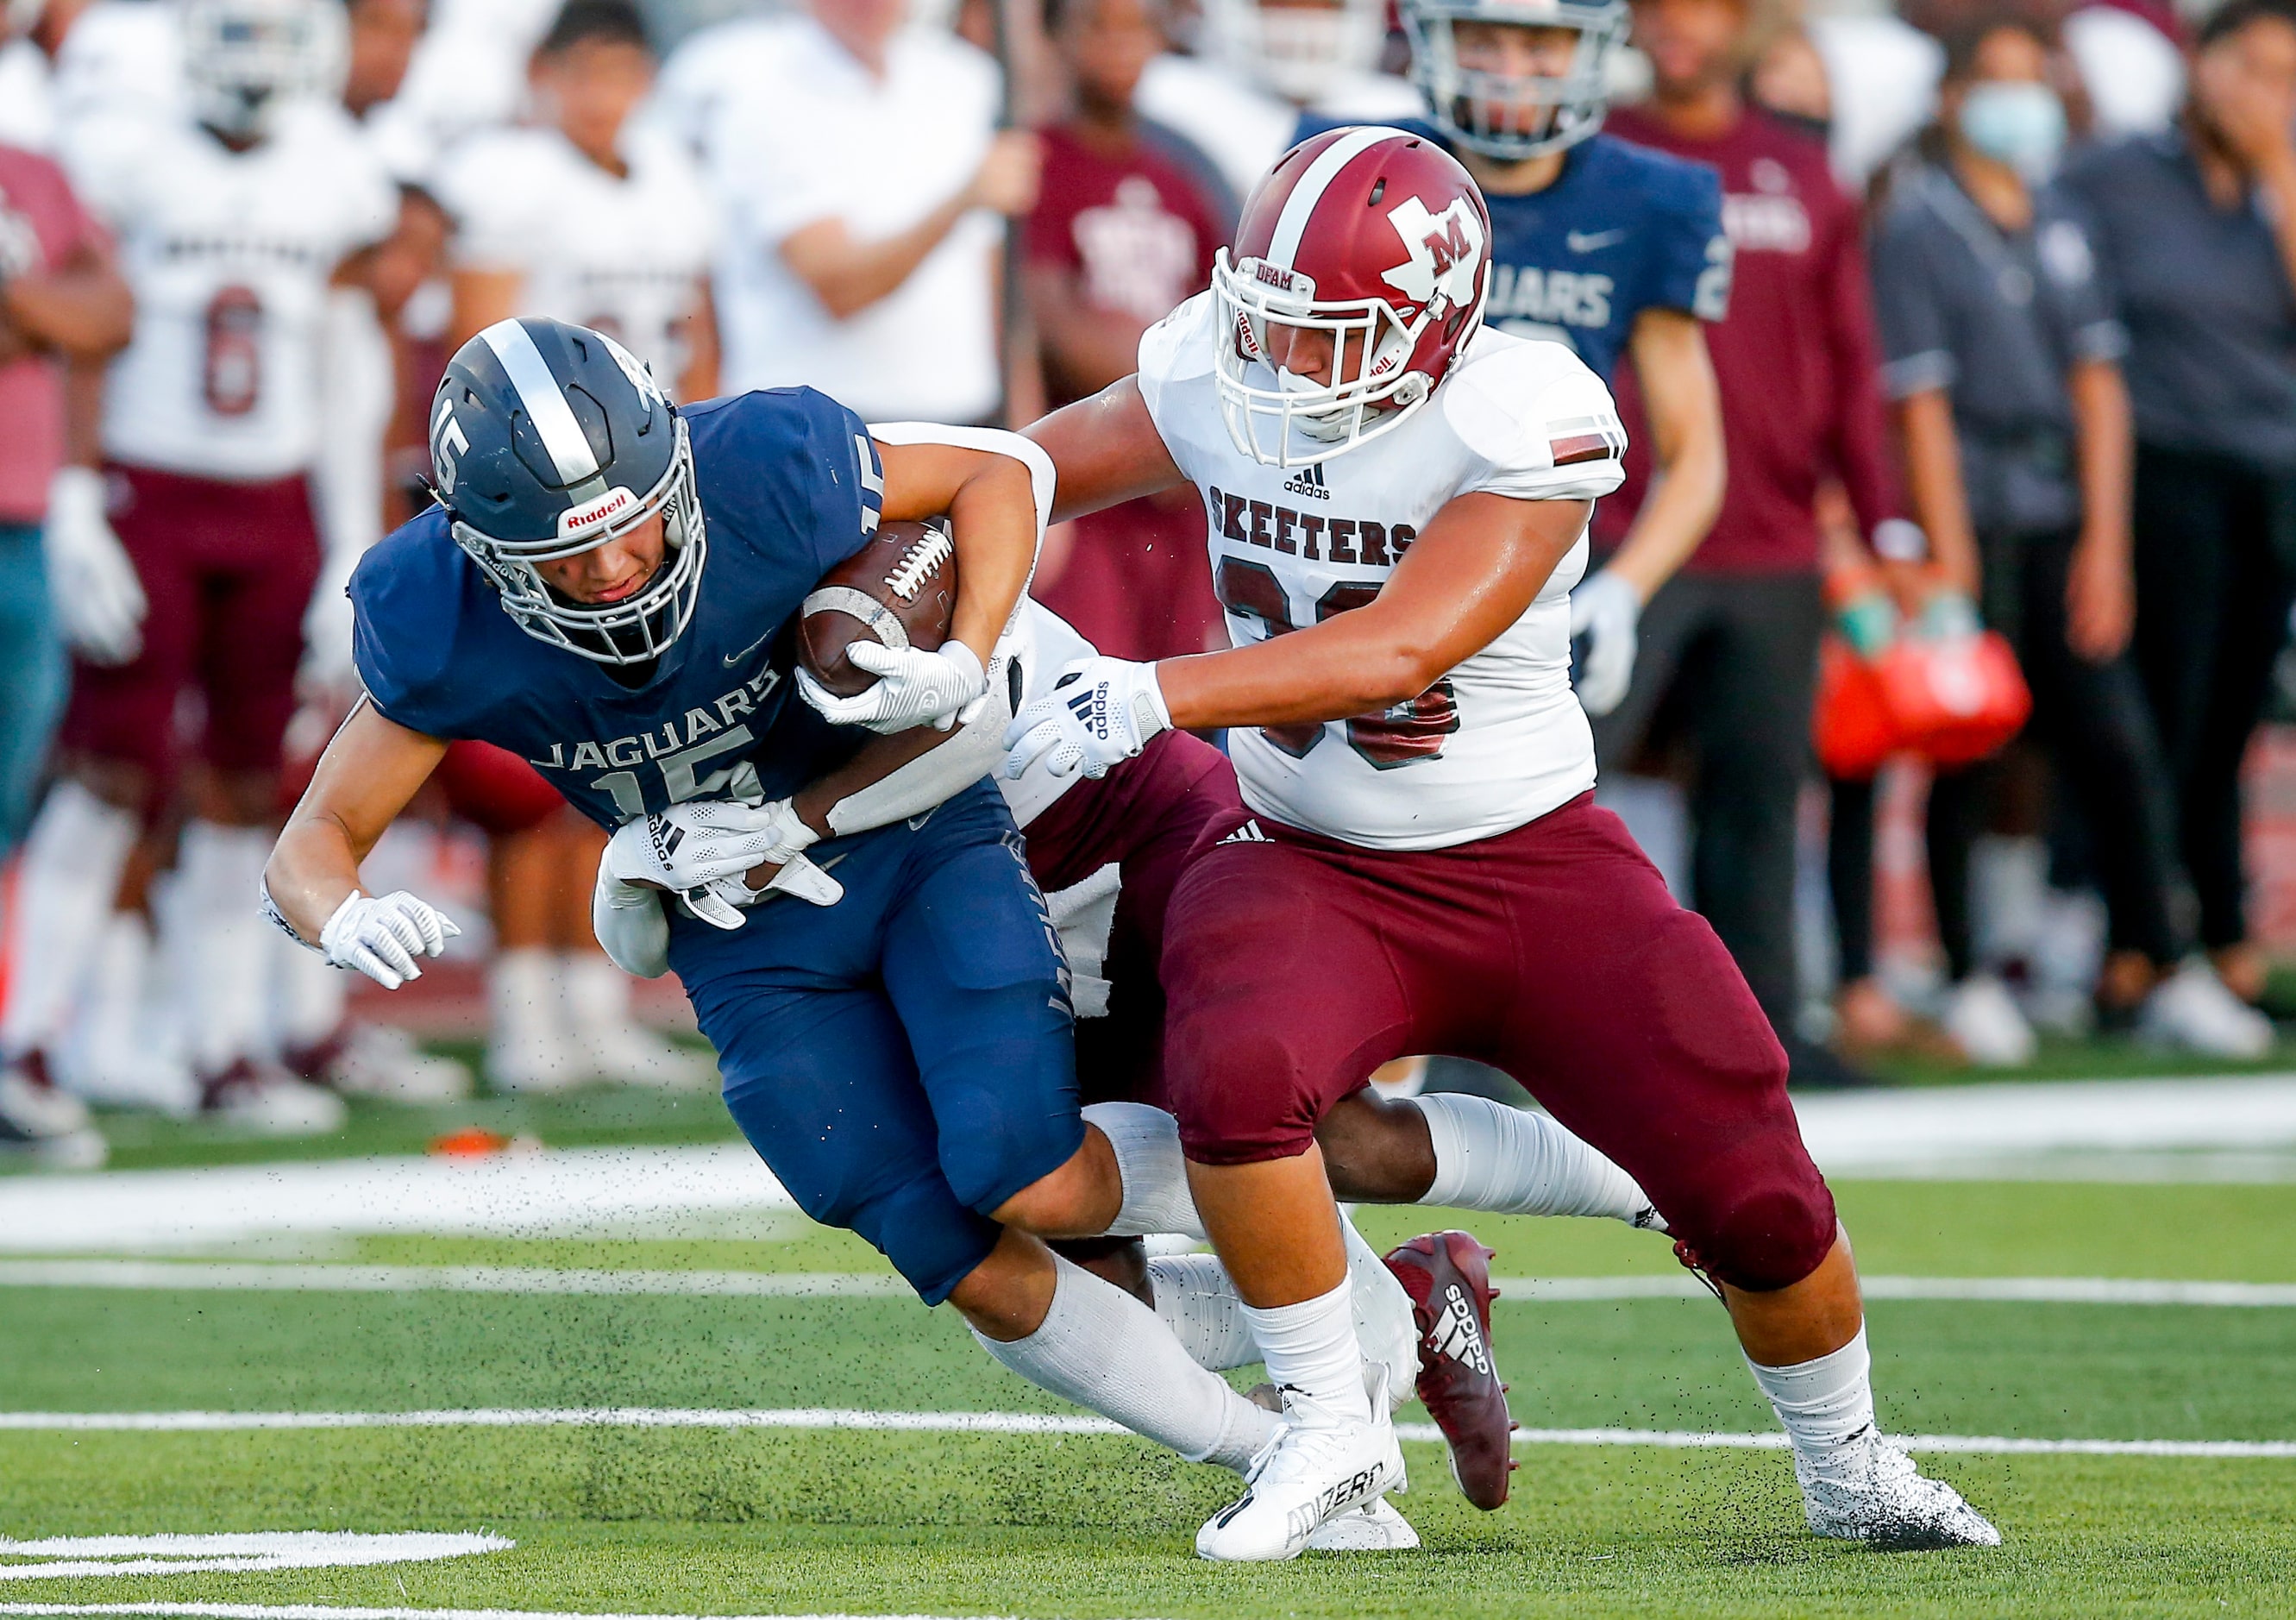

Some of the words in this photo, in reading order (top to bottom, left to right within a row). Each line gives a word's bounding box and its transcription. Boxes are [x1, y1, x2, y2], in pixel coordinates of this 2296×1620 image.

[1421, 212, 1472, 280] M
[1486, 263, 1615, 328] UARS
[1238, 311, 1259, 354] iddell
[430, 398, 471, 495] 15
[567, 493, 627, 530] Riddell
[1283, 479, 1331, 500] adidas
[1209, 486, 1417, 568] SKEETERS
[530, 660, 781, 771] JAGUARS
[1095, 681, 1109, 740] adidas
[1445, 1284, 1490, 1376] adidas
